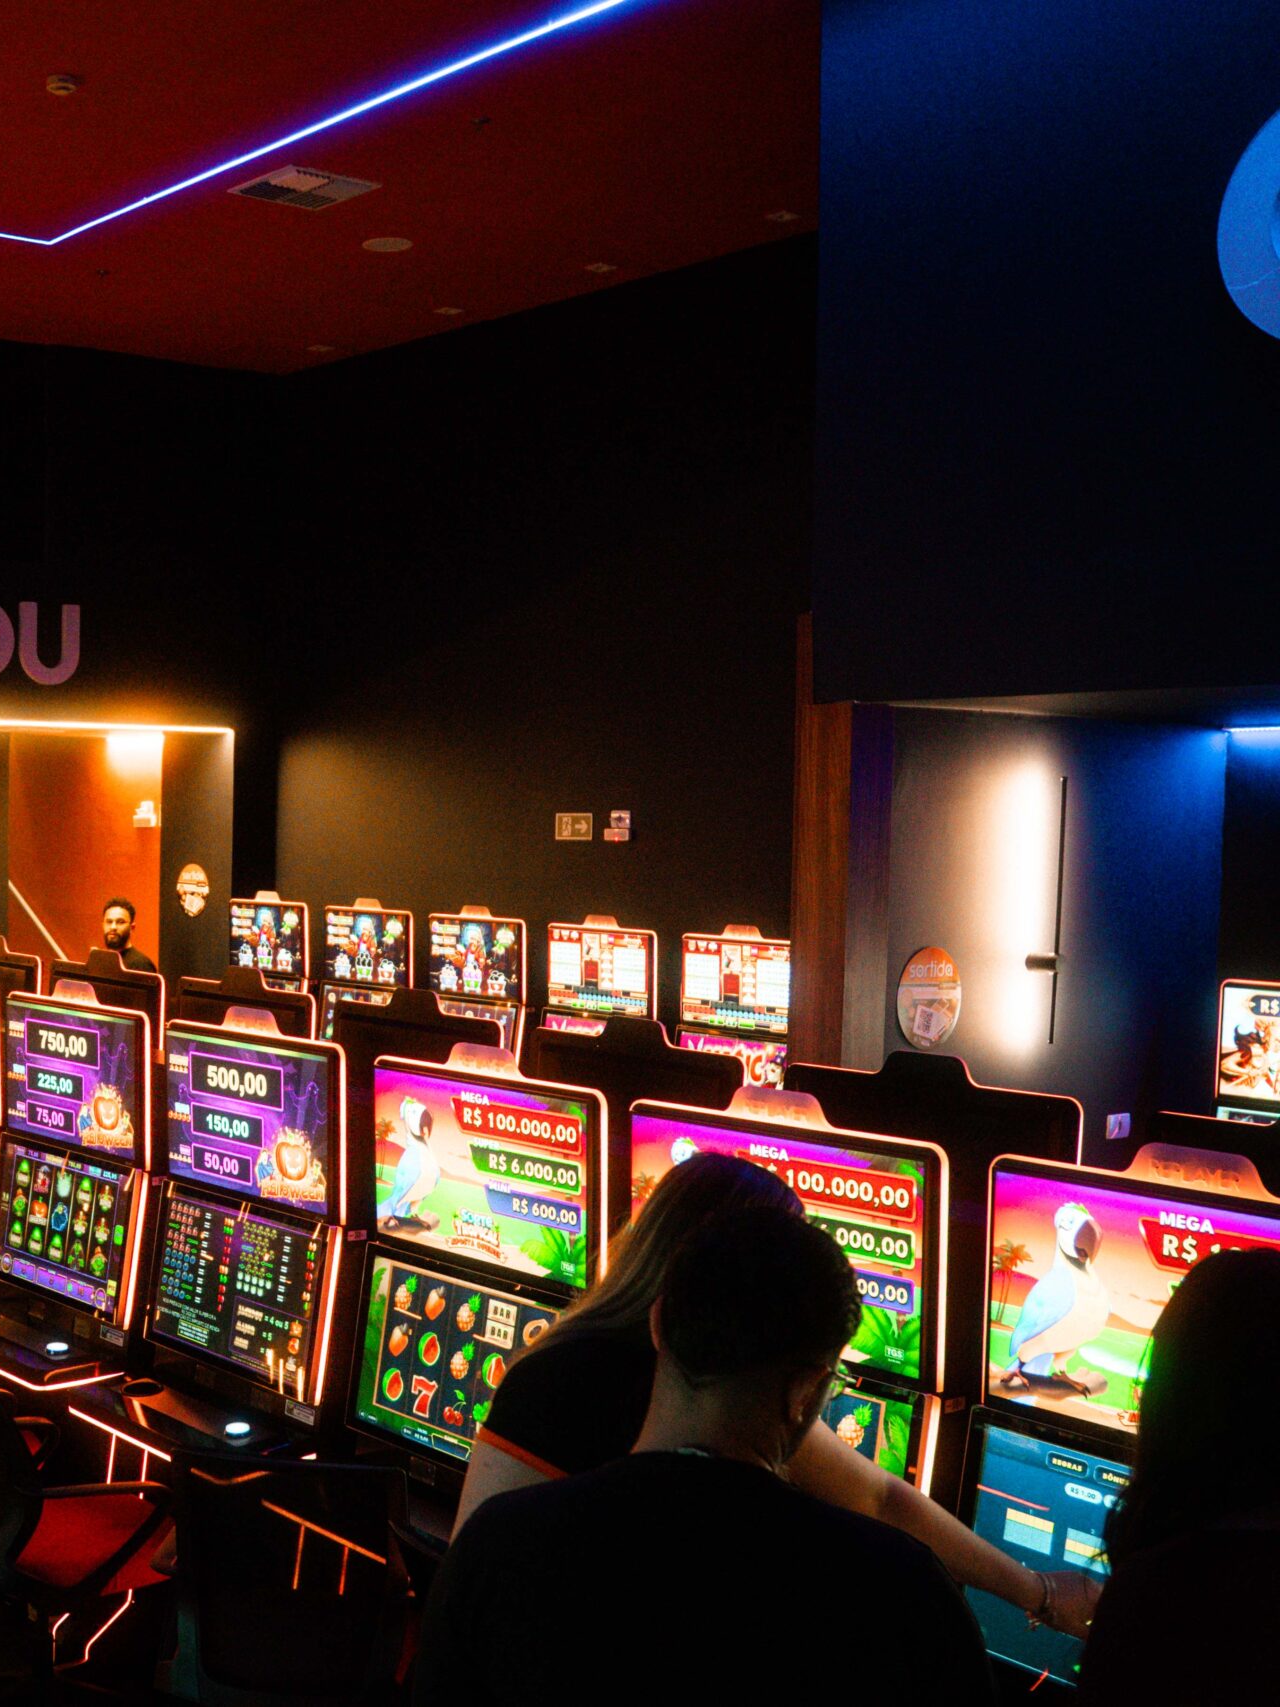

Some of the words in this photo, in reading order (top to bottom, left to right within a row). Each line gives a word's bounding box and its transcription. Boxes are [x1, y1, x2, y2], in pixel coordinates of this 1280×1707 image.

[38, 1029, 88, 1058] 750,00
[37, 1072, 73, 1094] 225,00
[206, 1064, 267, 1097] 500,00
[461, 1091, 489, 1106] MEGA
[36, 1107, 65, 1127] 75,00
[205, 1113, 250, 1138] 150,00
[463, 1107, 482, 1128] R$
[487, 1111, 577, 1144] 100.000,00
[203, 1151, 239, 1176] 50,00
[749, 1144, 789, 1162] MEGA
[489, 1153, 507, 1173] R$
[511, 1162, 577, 1187] 6.000,00
[785, 1168, 910, 1209] 100.000,00
[512, 1198, 528, 1215] R$
[532, 1202, 578, 1226] 600,00
[1159, 1211, 1215, 1235] MEGA
[818, 1224, 908, 1259] 000,00
[1162, 1233, 1198, 1264] R$
[857, 1278, 908, 1304] 00,00
[493, 1305, 511, 1319] BAR
[490, 1326, 508, 1340] BAR
[1051, 1457, 1083, 1472] REGRAS
